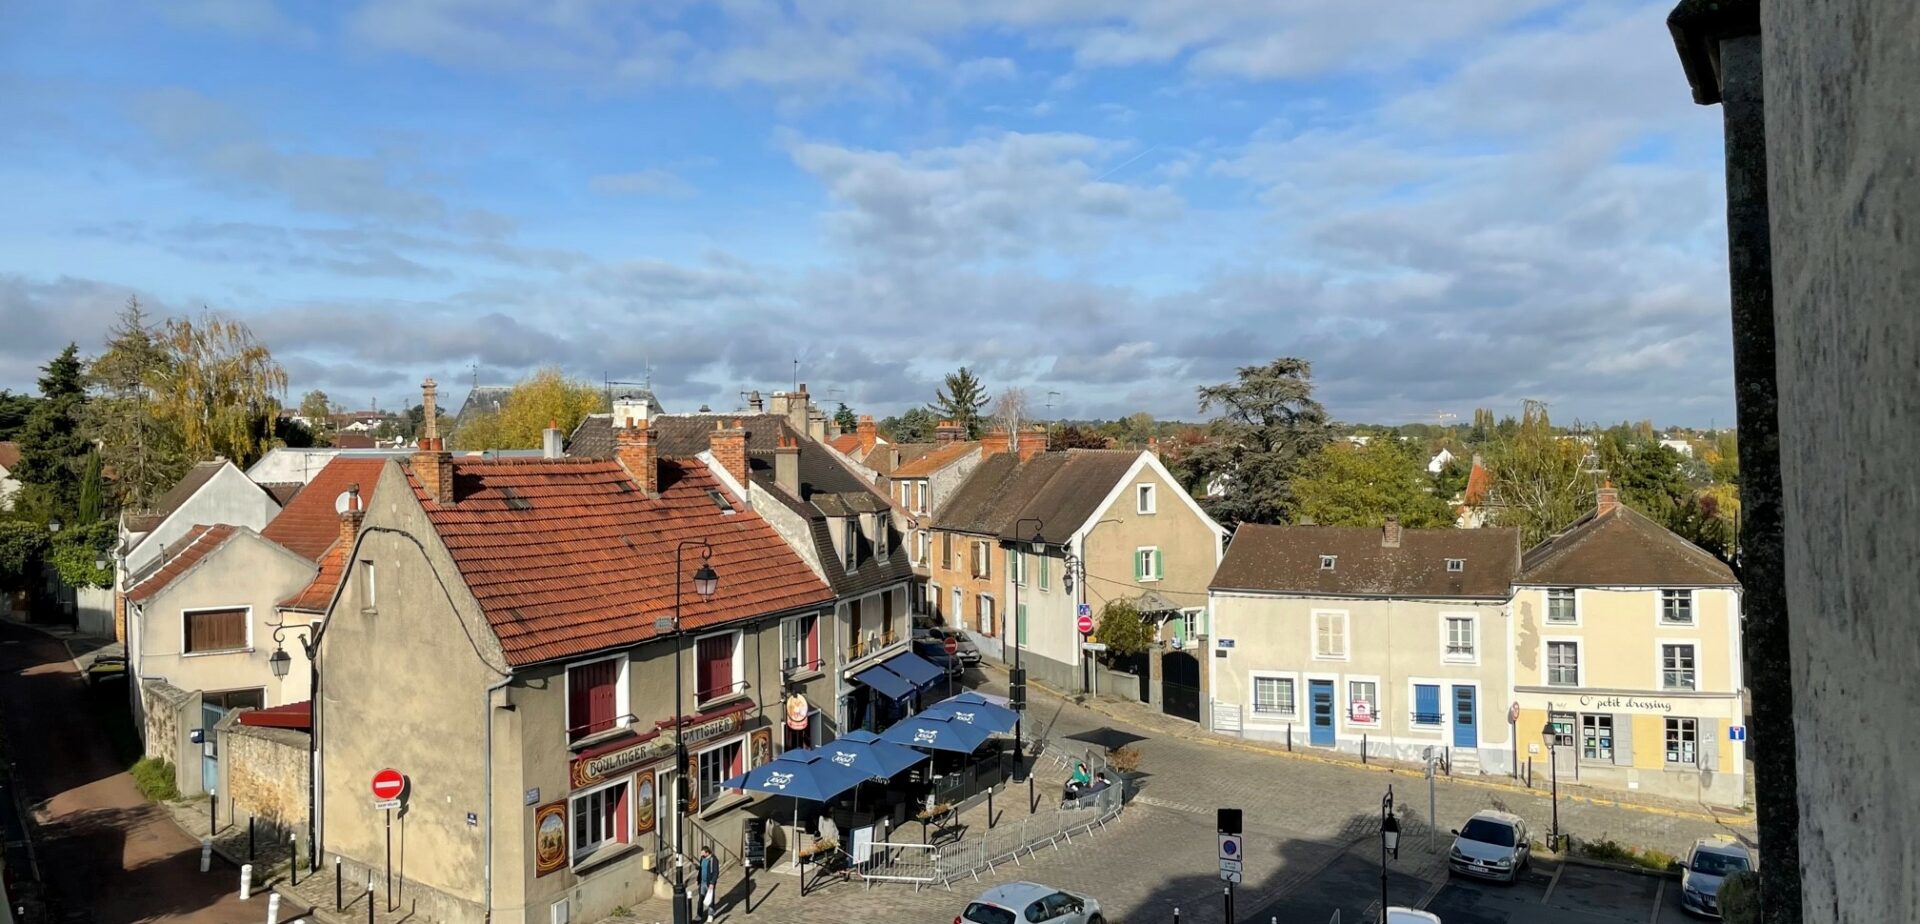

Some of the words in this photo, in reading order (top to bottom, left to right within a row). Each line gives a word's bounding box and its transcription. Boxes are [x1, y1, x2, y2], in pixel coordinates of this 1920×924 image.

[1597, 697, 1621, 710] petit
[1625, 699, 1672, 712] dressing
[590, 745, 647, 776] BOULANGER
[682, 718, 730, 744] PATISSIER
